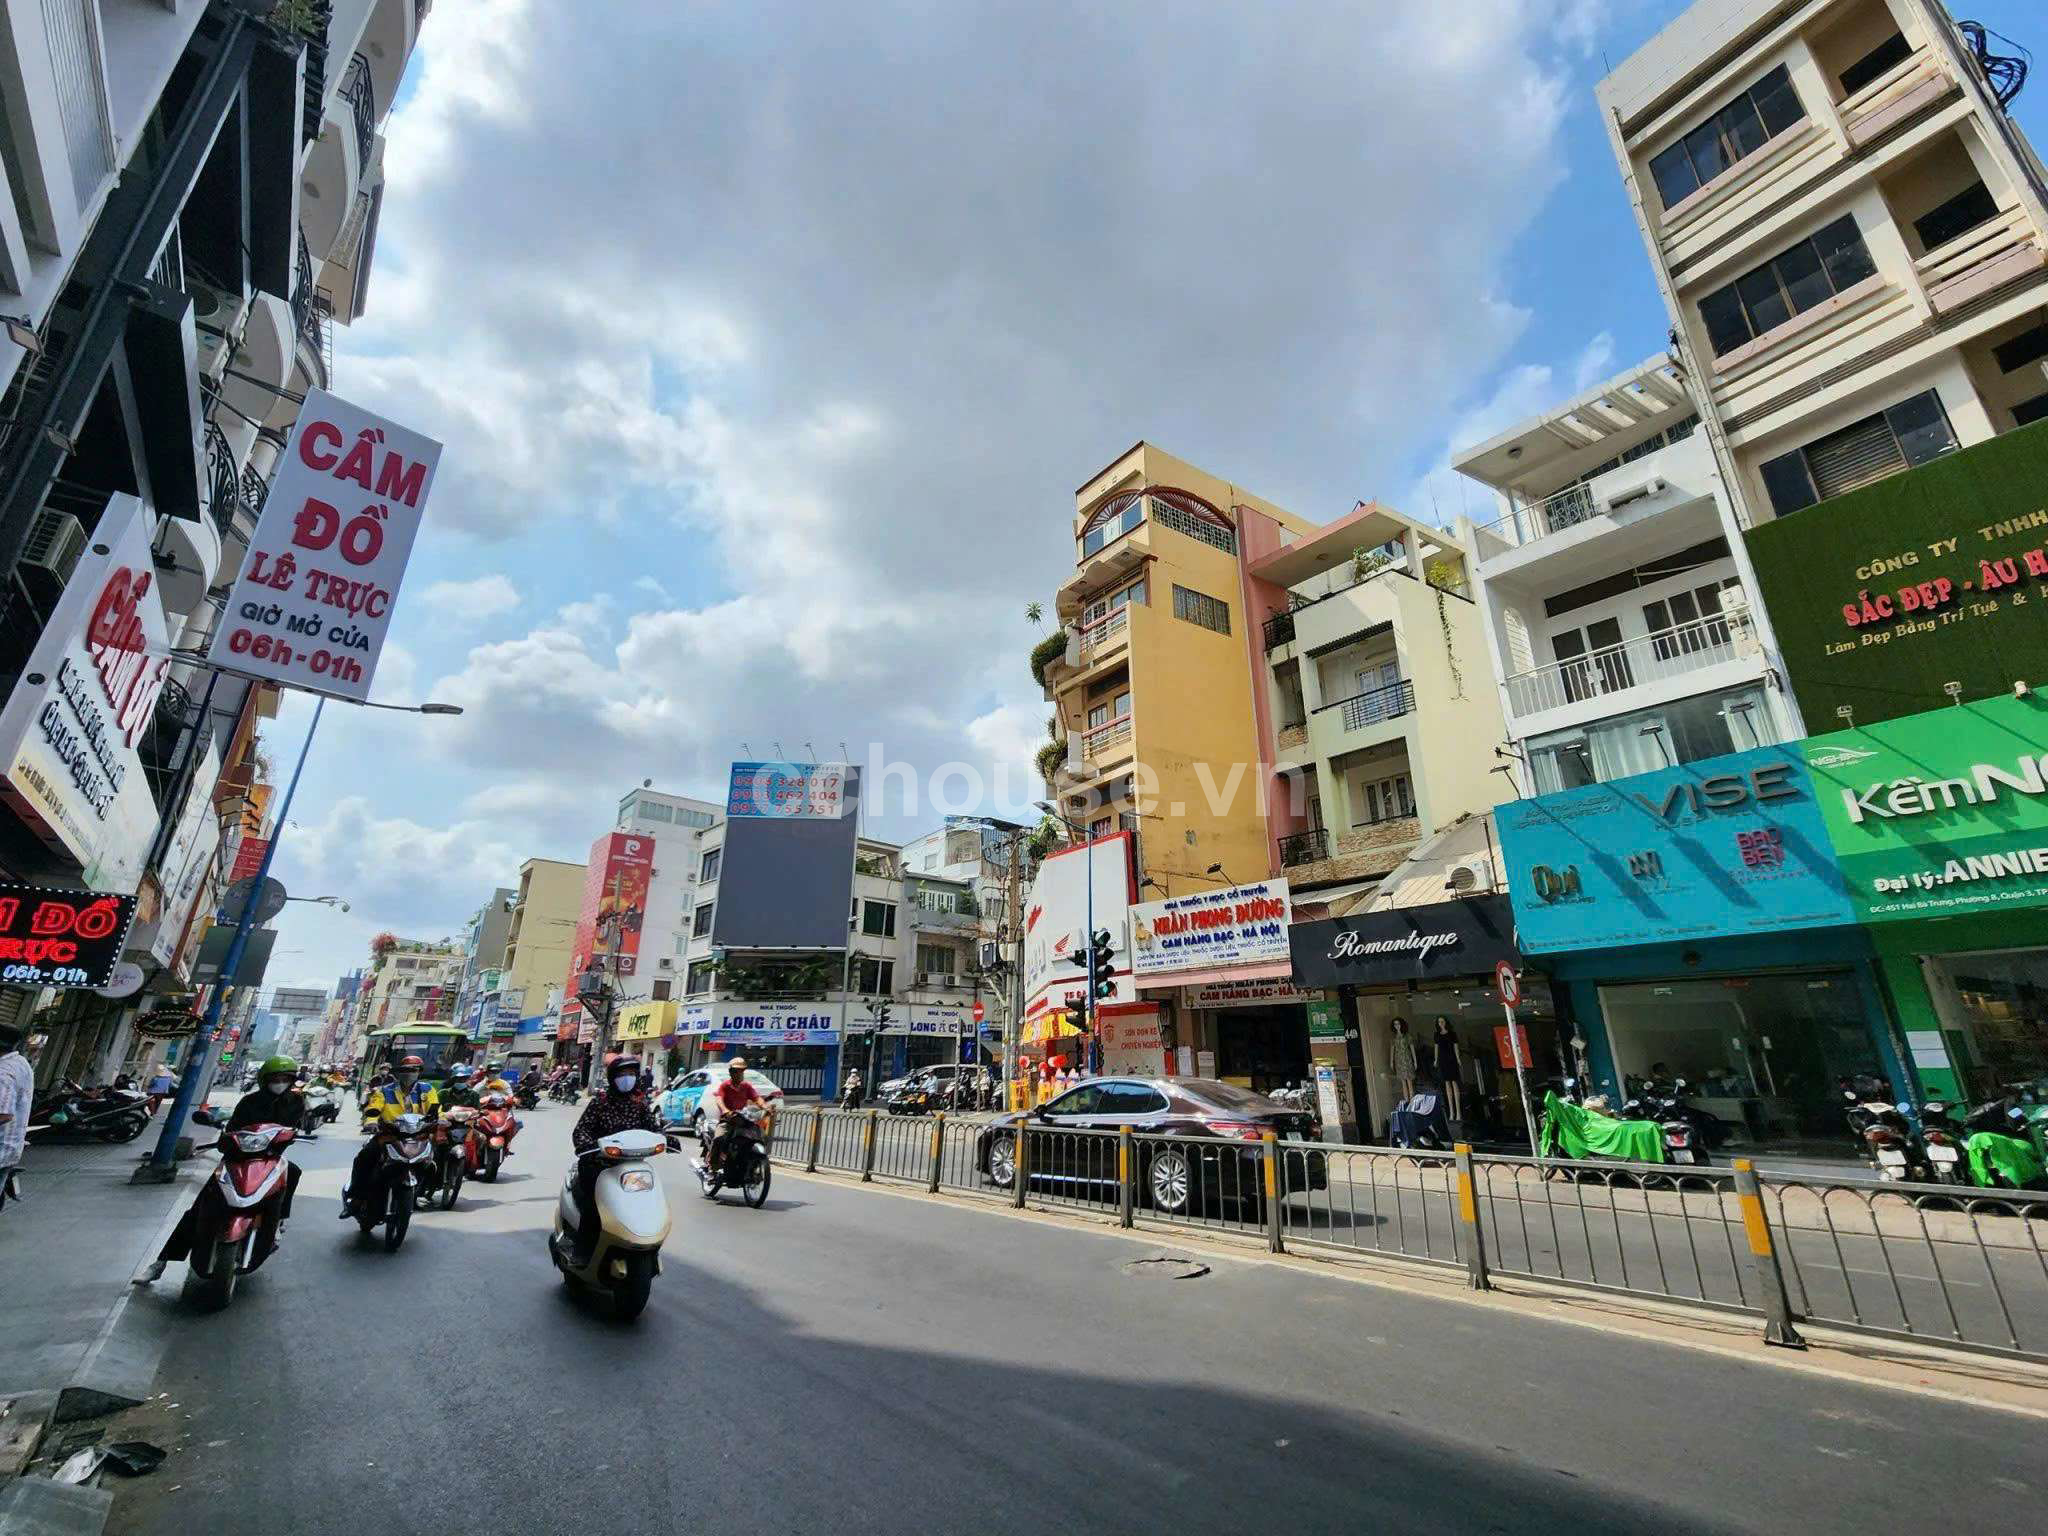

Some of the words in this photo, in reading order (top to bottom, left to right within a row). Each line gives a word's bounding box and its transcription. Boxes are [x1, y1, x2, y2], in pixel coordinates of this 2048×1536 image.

[299, 421, 427, 508] CẦM
[292, 497, 388, 566] ĐỒ
[1856, 551, 1919, 580] CÔNG
[1928, 537, 1958, 557] TY
[1977, 509, 2048, 541] TNHH
[246, 550, 297, 591] LÊ
[304, 568, 389, 620] TRỰC
[1842, 588, 1894, 627] SẮC
[1898, 577, 1952, 611] ĐẸP
[1979, 557, 2018, 591] ÂU
[239, 600, 282, 626] GIỜ
[286, 609, 324, 638] MỞ
[328, 618, 370, 652] CỬA
[1825, 640, 1856, 657] Làm
[1861, 631, 1891, 647] Đẹp
[1895, 619, 1936, 638] Bằng
[1939, 607, 1964, 625] Trí
[2012, 592, 2028, 606] &
[811, 777, 839, 788] 017
[1633, 762, 1801, 817] VISE
[1164, 900, 1179, 910] NHÀ
[1180, 895, 1203, 909] THUỐC
[1203, 896, 1209, 905] Y
[1209, 893, 1225, 904] HỌC
[1226, 888, 1240, 900] CỔ
[1240, 884, 1268, 898] TRUYỀN
[1874, 874, 1909, 893] Đại
[31, 897, 119, 939] ĐỒ
[1190, 905, 1233, 931] PHONG
[1234, 896, 1286, 925] ĐƯỜNG
[1161, 936, 1182, 949] CAM
[1184, 932, 1212, 947] HÀNG
[1213, 930, 1234, 946] BẠC
[1242, 924, 1258, 940] HÀ
[1260, 921, 1281, 937] NỘI
[1327, 929, 1459, 961] Romantique
[1200, 990, 1220, 1001] CAM
[1221, 988, 1250, 1000] HÀNG
[722, 1016, 765, 1030] LONG
[786, 1013, 831, 1030] CHÂU
[910, 1022, 936, 1032] LONG
